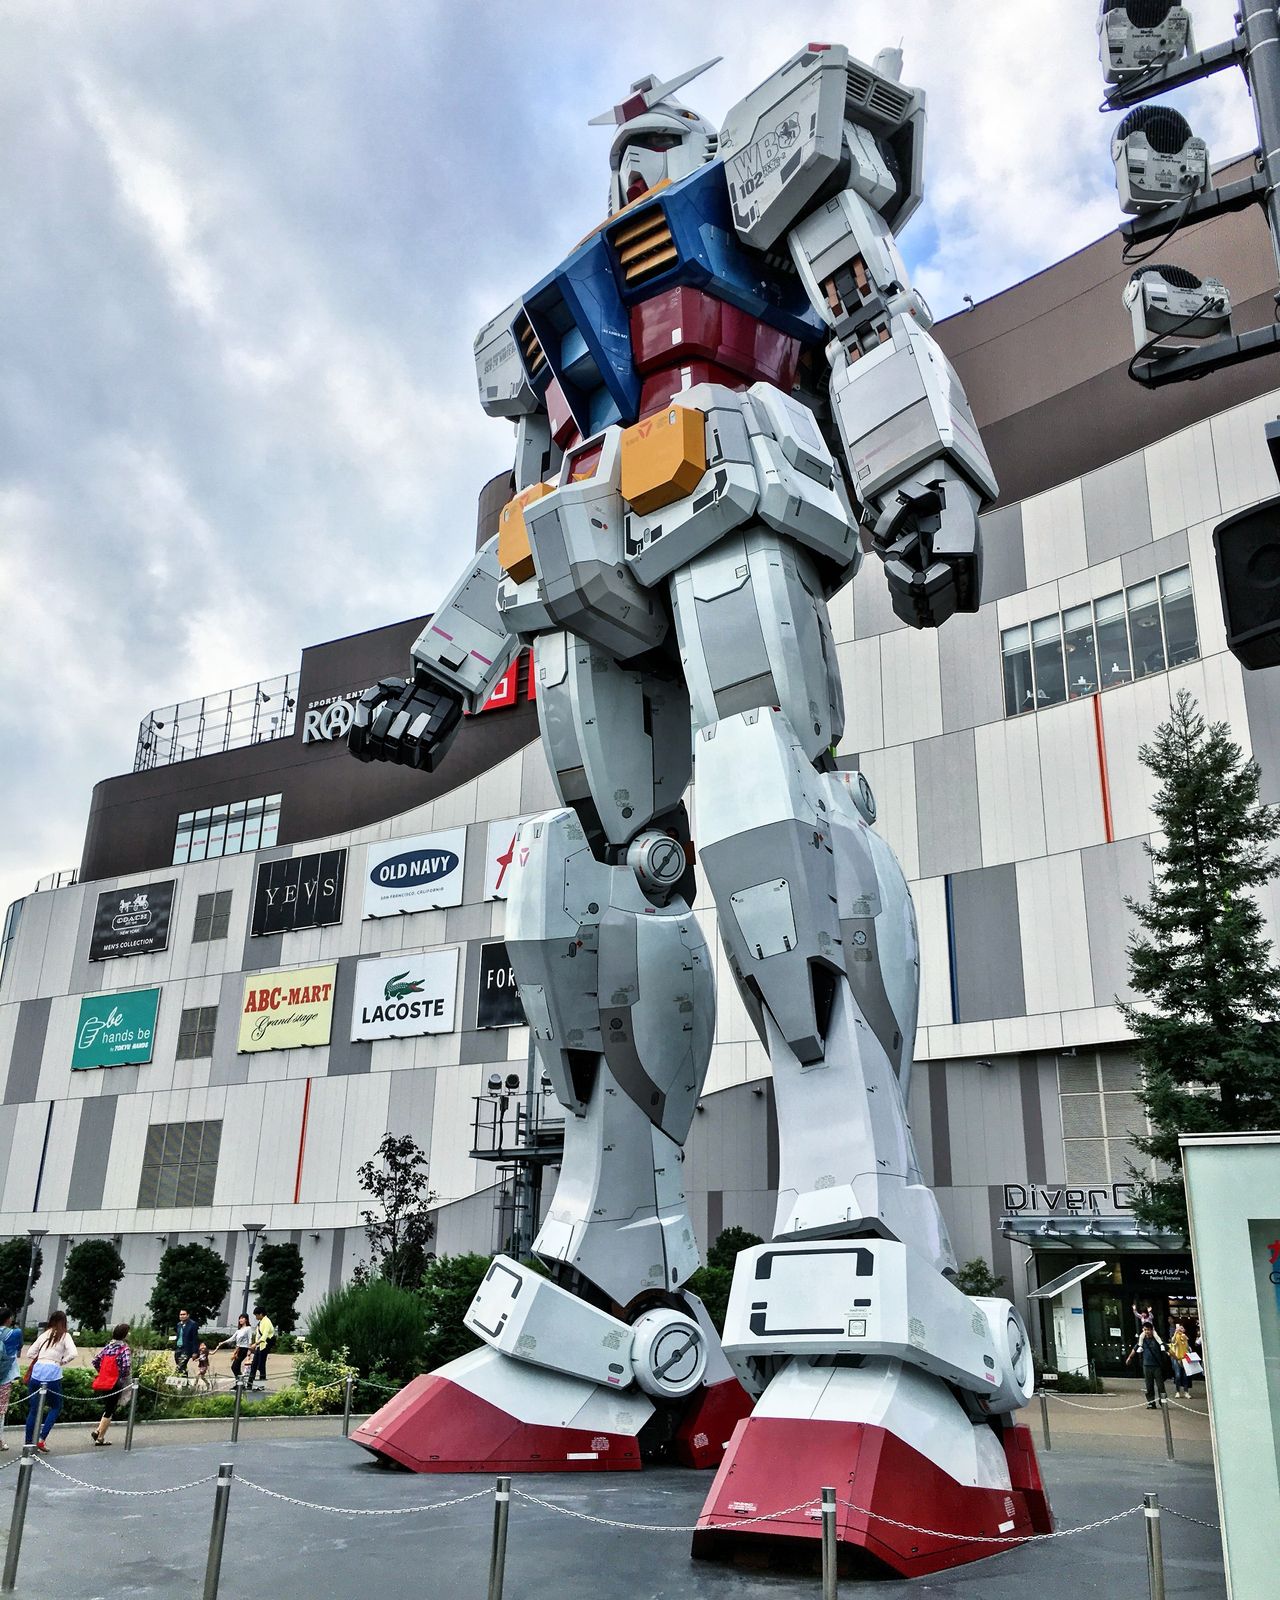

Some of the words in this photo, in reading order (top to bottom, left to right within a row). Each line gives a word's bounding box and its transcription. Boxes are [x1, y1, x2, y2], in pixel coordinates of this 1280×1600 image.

[739, 171, 765, 199] 102
[308, 696, 343, 709] SPORTS
[379, 863, 408, 882] OLD
[409, 855, 451, 877] NAVY
[265, 878, 335, 905] YEVS
[116, 913, 148, 924] COACH
[103, 942, 119, 951] MEN'S
[119, 938, 154, 949] COLLECTION
[244, 983, 332, 1013] ABC-MART
[361, 998, 445, 1024] LACOSTE
[105, 1006, 124, 1029] be
[251, 1013, 296, 1041] Grand
[292, 1012, 319, 1027] stage
[102, 1029, 134, 1044] hands
[137, 1028, 151, 1040] be
[114, 1043, 131, 1052] TOKYU
[131, 1042, 149, 1050] HANDS
[1003, 1183, 1144, 1211] DiverC
